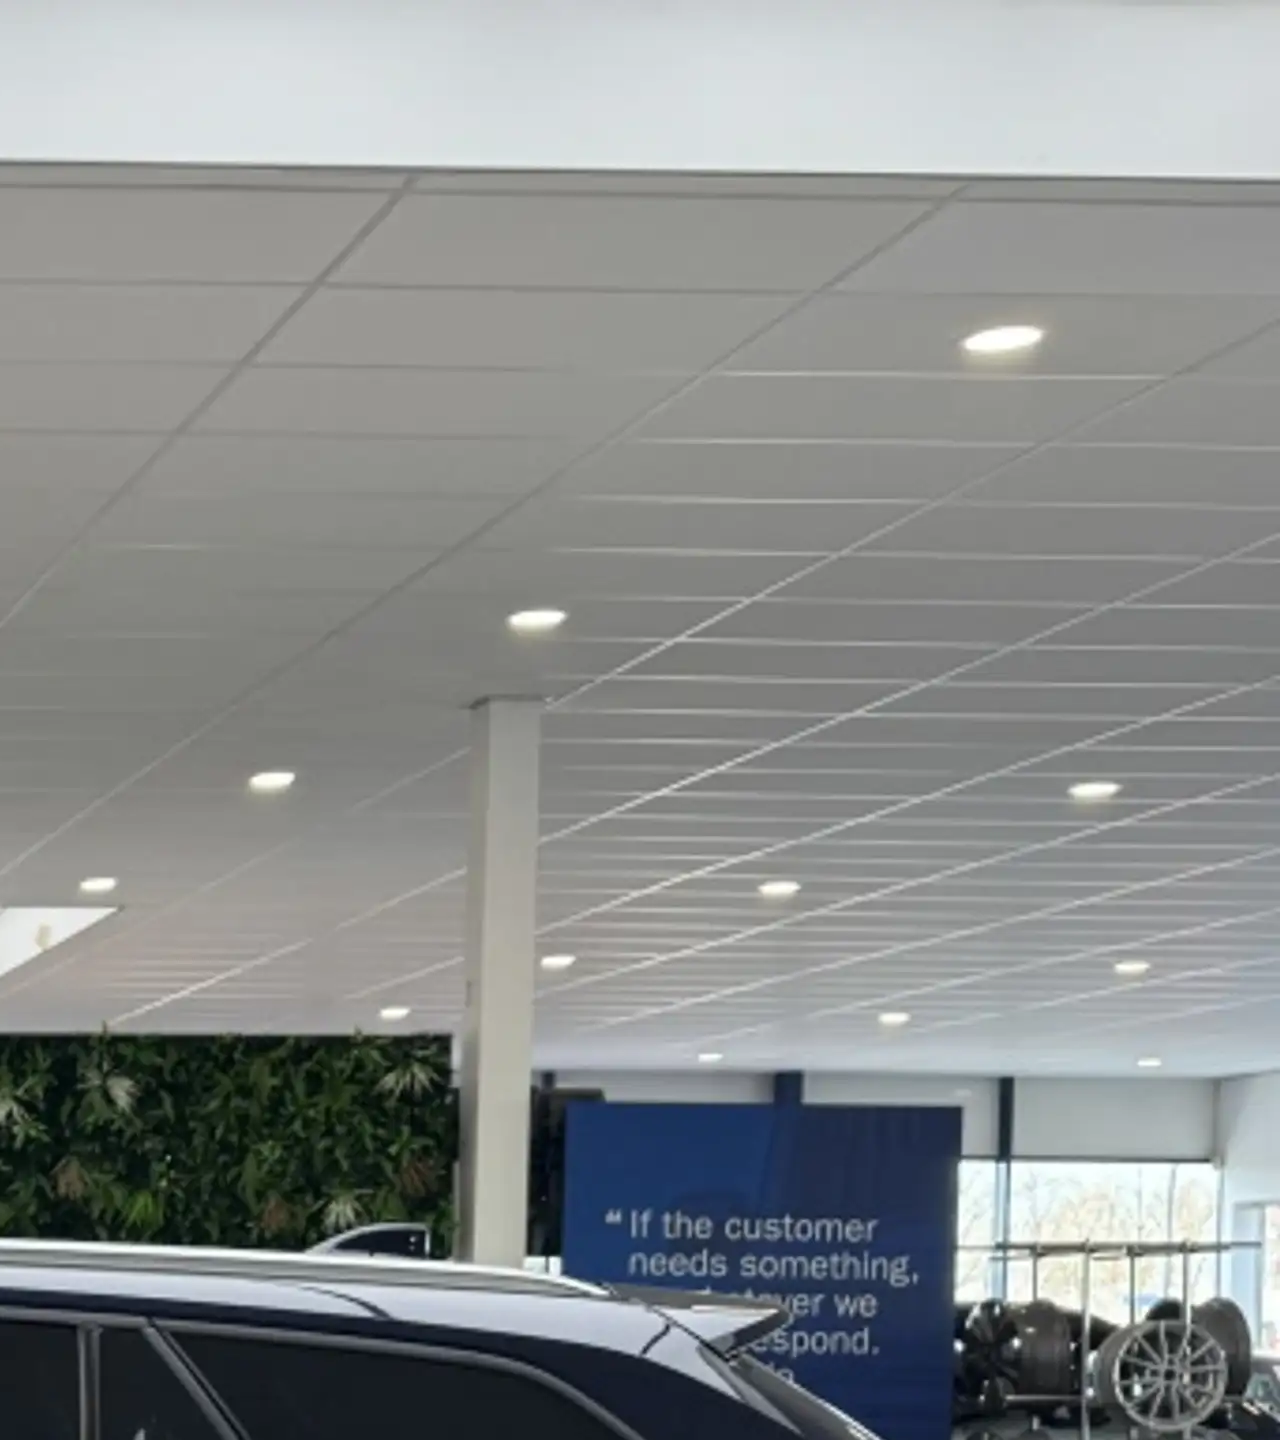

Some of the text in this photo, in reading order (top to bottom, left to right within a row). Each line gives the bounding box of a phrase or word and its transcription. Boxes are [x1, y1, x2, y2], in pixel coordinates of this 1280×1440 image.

[661, 1211, 713, 1240] the
[724, 1214, 878, 1243] customer
[628, 1248, 919, 1287] needs something,
[833, 1297, 877, 1317] we
